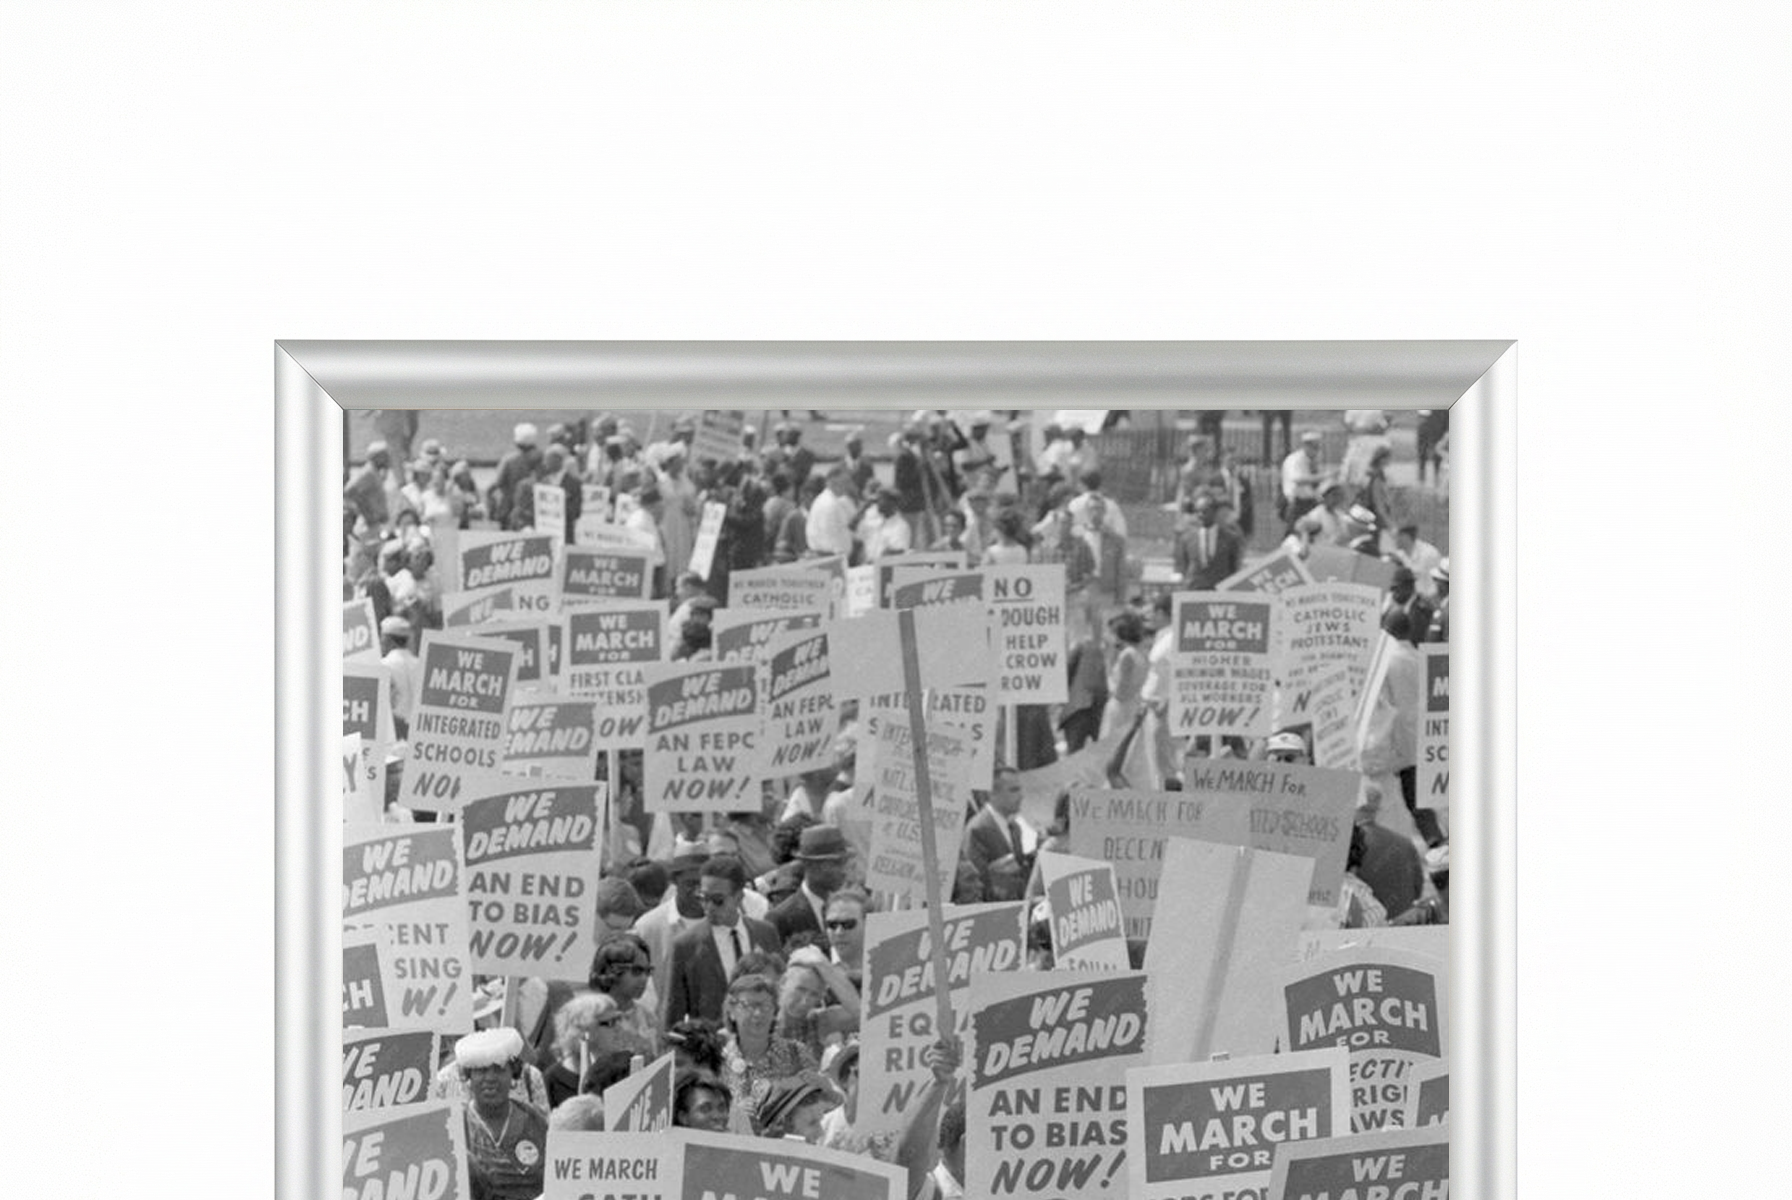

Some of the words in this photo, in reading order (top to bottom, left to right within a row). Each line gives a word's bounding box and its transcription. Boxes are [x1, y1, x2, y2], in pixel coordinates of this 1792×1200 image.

[490, 541, 524, 562] WE
[467, 556, 550, 588] DEMAND
[592, 557, 618, 571] WE
[570, 569, 638, 587] MARCH
[995, 577, 1033, 597] NO
[742, 593, 815, 606] CATHOLIC
[600, 615, 627, 630] WE
[1208, 604, 1238, 619] WE
[1293, 607, 1367, 624] CATHOLIC
[1184, 621, 1263, 640] MARCH
[1306, 622, 1351, 635] JEWS
[576, 630, 653, 652] MARCH
[794, 637, 824, 658] WE
[1006, 633, 1049, 649] HELP
[1204, 640, 1237, 650] FOR
[1291, 635, 1370, 651] PROTESTANT
[457, 650, 484, 670] WE
[599, 652, 630, 661] FOR
[1006, 652, 1058, 669] CROW
[1192, 656, 1252, 666] HIGHER
[429, 668, 504, 697] MARCH
[570, 671, 610, 688] FIRST
[682, 672, 722, 697] WE
[1175, 668, 1226, 680] MINIMUM
[1231, 668, 1271, 681] WAGES
[1178, 681, 1238, 692] COVERAGE
[1242, 682, 1267, 693] FOR
[449, 694, 479, 708] FOR
[653, 688, 750, 728] DEMAND
[1202, 693, 1263, 704] WORKERS
[510, 707, 556, 731] WE
[772, 702, 796, 720] AN
[1180, 706, 1260, 728] NOW!
[416, 713, 501, 740] INTEGRATED
[785, 720, 823, 739] LAW
[504, 727, 589, 757] MAND
[656, 734, 690, 751] AN
[700, 731, 755, 750] FEPC
[771, 735, 831, 766] NOW!
[412, 742, 497, 768] SCHOOLS
[677, 755, 736, 773] LAW
[662, 777, 751, 799] NOW!
[1217, 770, 1274, 793] MARCH
[505, 793, 556, 822] WE
[1108, 799, 1168, 823] MARCH
[466, 815, 592, 859] DEMAND
[362, 839, 412, 873] WE
[468, 872, 511, 895] AN
[521, 876, 584, 898] END
[1069, 874, 1094, 907] WE
[468, 902, 505, 923] TO
[513, 904, 580, 927] BIAS
[1059, 901, 1118, 948] DEMAND
[388, 924, 450, 946] ENT
[469, 930, 578, 963] NOW!
[393, 957, 462, 980] SING
[1333, 969, 1384, 997] WE
[1029, 988, 1094, 1030] WE
[1299, 997, 1430, 1046] MARCH
[983, 1013, 1142, 1078] DEMAND
[987, 1088, 1042, 1118] AN
[1054, 1085, 1128, 1114] END
[1210, 1082, 1266, 1112] WE
[990, 1124, 1036, 1151] TO
[1045, 1119, 1128, 1149] BIAS
[1160, 1107, 1319, 1155] MARCH
[554, 1158, 582, 1180] WE
[588, 1157, 657, 1180] MARCH
[1209, 1150, 1272, 1171] FOR
[1352, 1154, 1406, 1182] WE
[759, 1160, 821, 1200] WE
[990, 1149, 1127, 1196] NOW!
